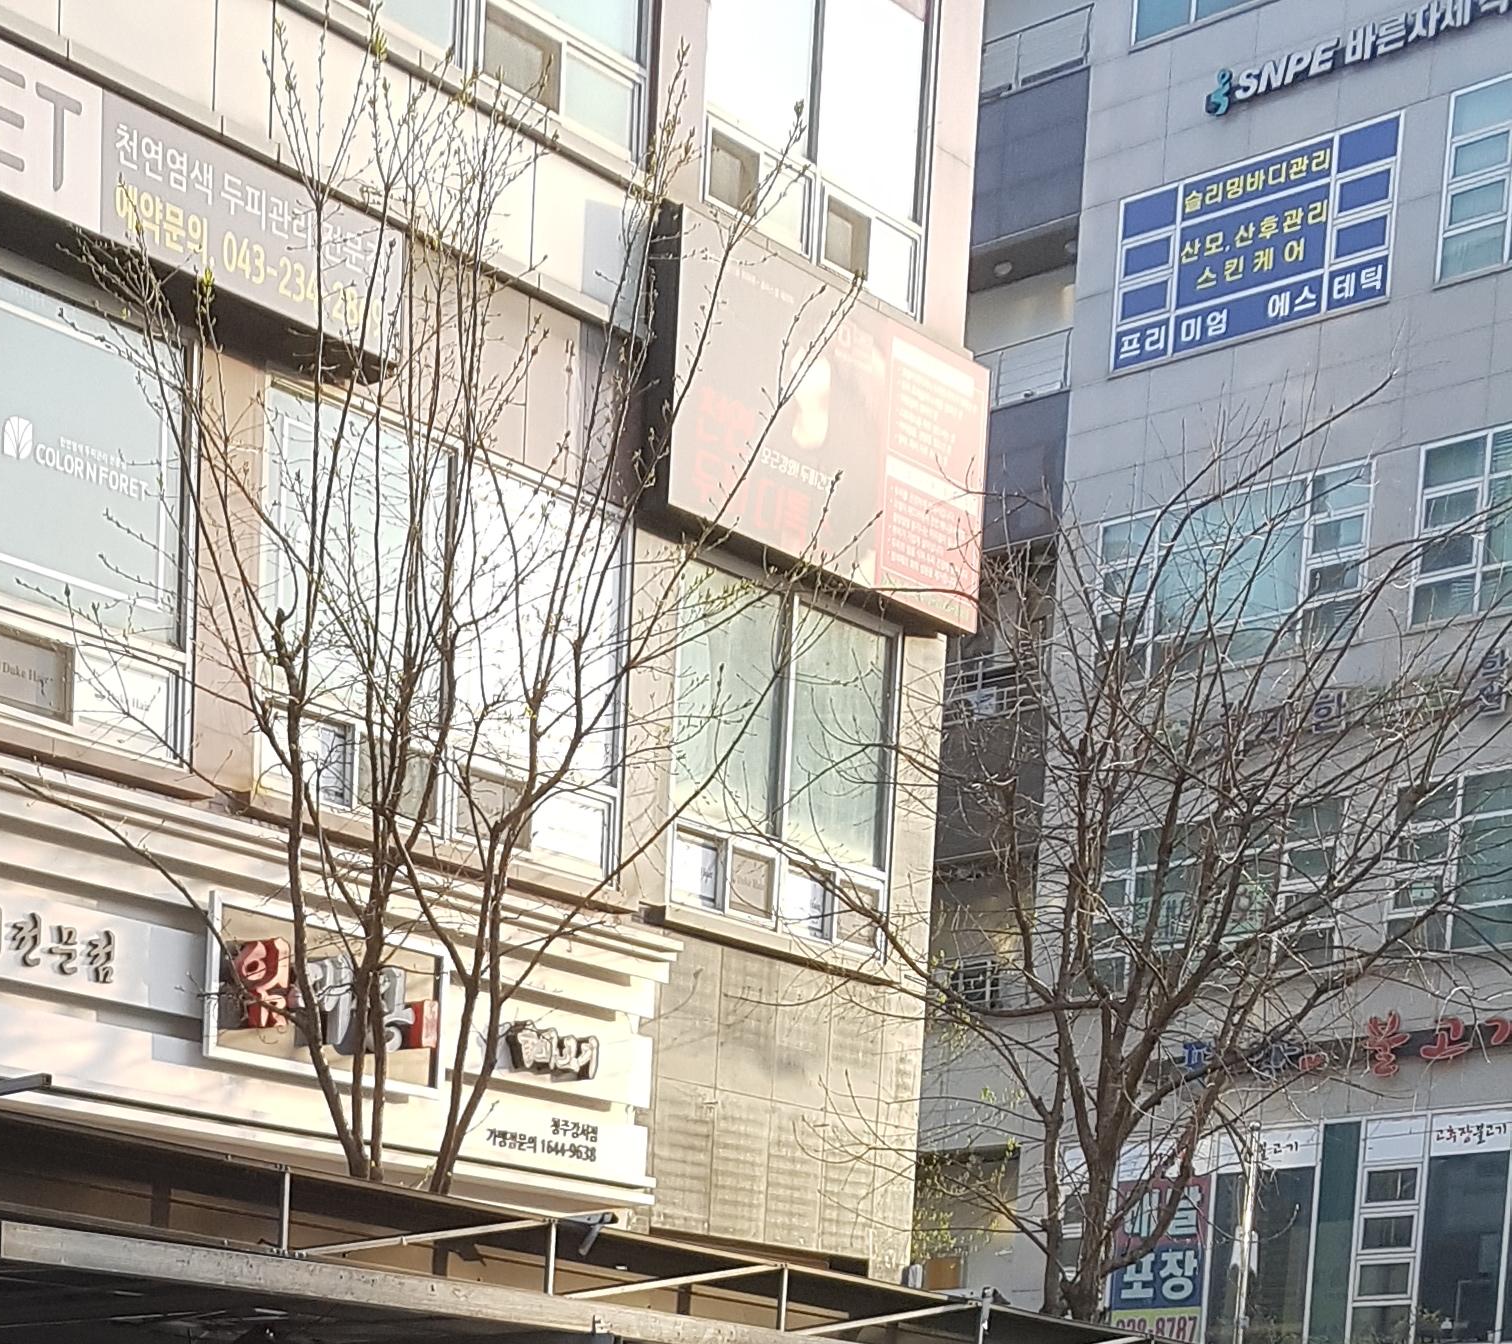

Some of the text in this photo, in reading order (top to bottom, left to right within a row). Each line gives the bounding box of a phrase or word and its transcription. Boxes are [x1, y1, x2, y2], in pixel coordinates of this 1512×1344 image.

[1235, 37, 1340, 100] SNPE
[115, 123, 214, 205] 천연염색
[220, 173, 313, 251] 두피관리
[1183, 148, 1331, 214] 슬리밍바디관리
[1195, 238, 1306, 291] 스킨케어
[1119, 264, 1384, 360] 프리미엄 에스테틱
[2, 661, 27, 678] Duke
[486, 1128, 597, 1162] 가맹점문의 1644-9638
[1435, 1121, 1508, 1145] 고추장불고기
[1120, 1248, 1199, 1301] 포장
